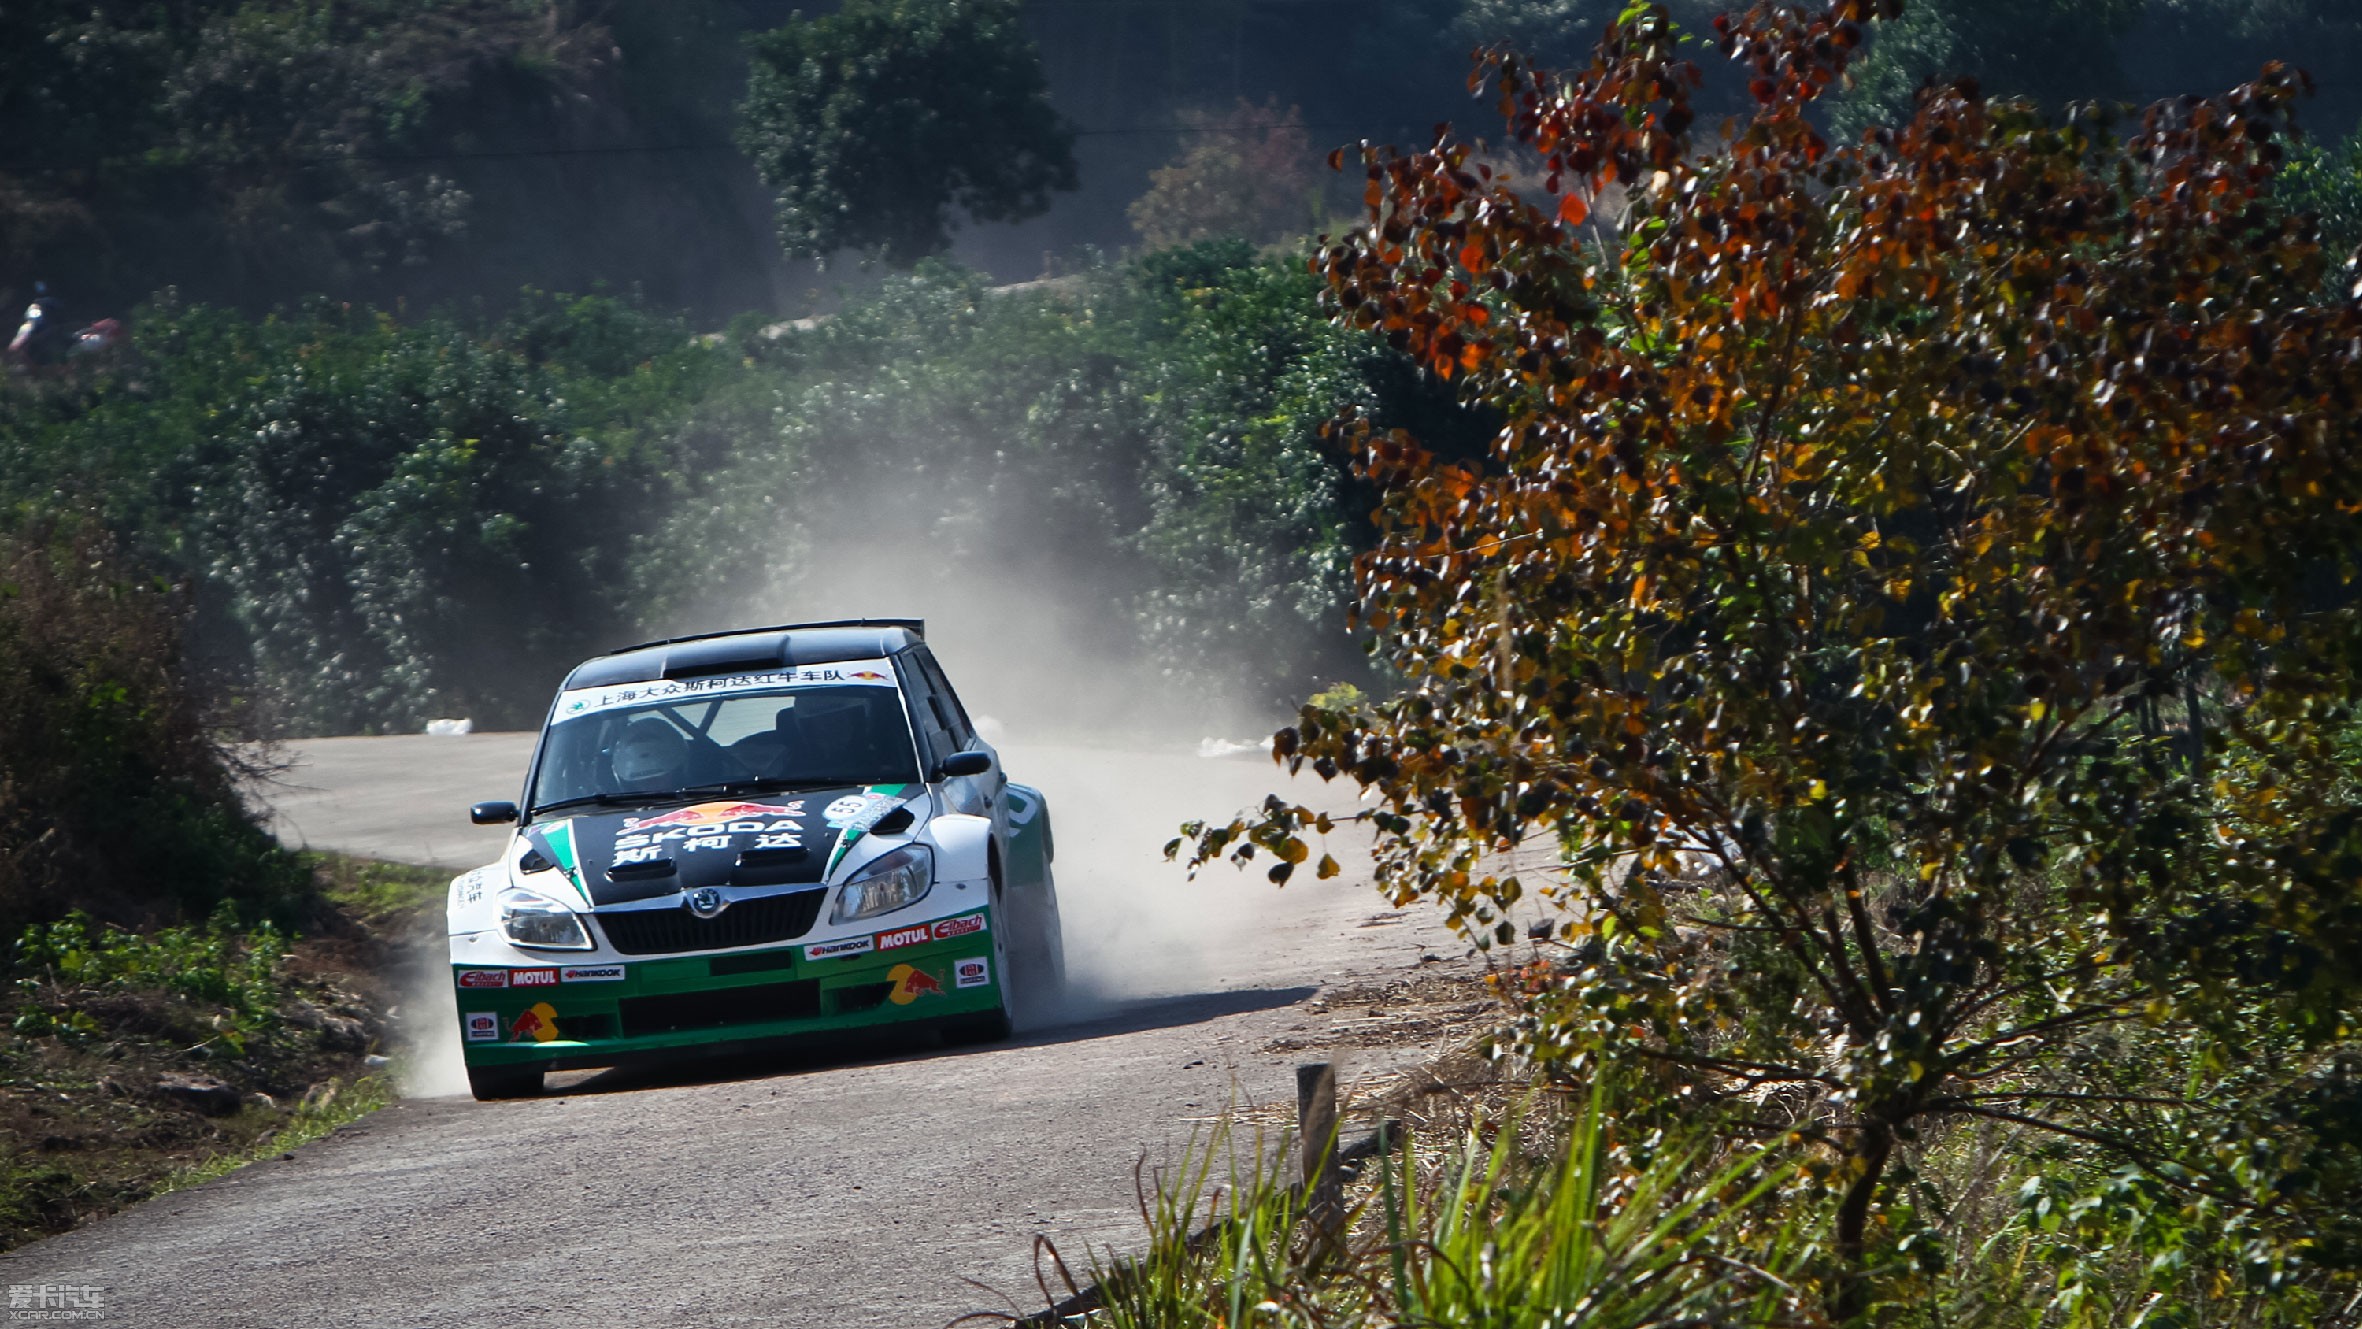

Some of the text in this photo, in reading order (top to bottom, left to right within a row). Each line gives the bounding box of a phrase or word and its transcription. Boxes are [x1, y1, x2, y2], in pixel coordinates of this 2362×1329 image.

[594, 669, 846, 707] 上海大众斯柯达红牛车队
[611, 833, 803, 867] 斯柯达
[879, 927, 929, 949] MOTUL
[512, 971, 557, 985] MOTUL
